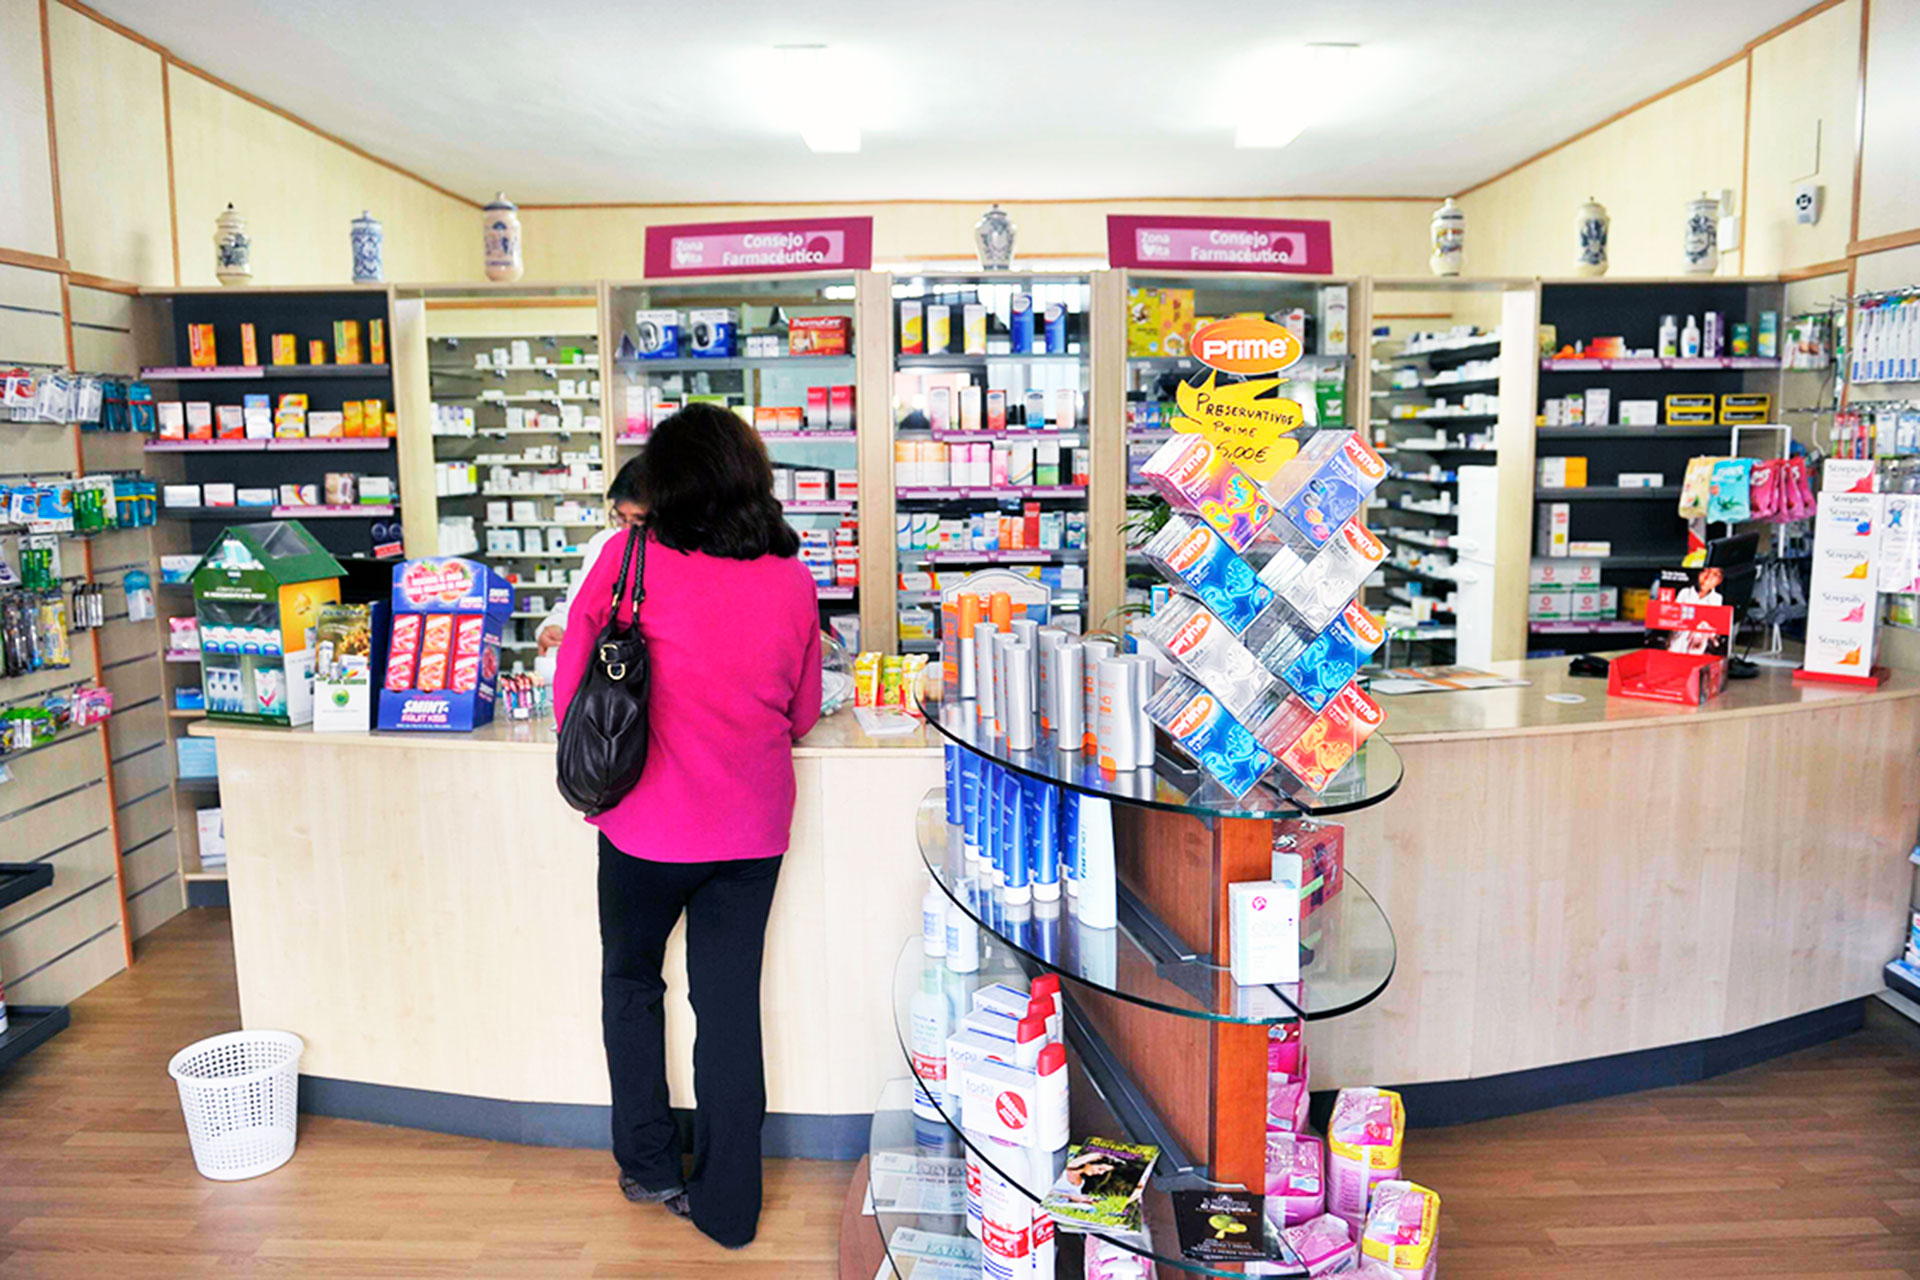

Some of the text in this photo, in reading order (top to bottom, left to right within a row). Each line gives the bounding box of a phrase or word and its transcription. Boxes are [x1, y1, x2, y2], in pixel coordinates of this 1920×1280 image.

[743, 232, 803, 249] Consejo
[1210, 230, 1268, 248] Consejo
[723, 248, 824, 266] Farmacéutico
[1190, 246, 1288, 264] Farmacéutico
